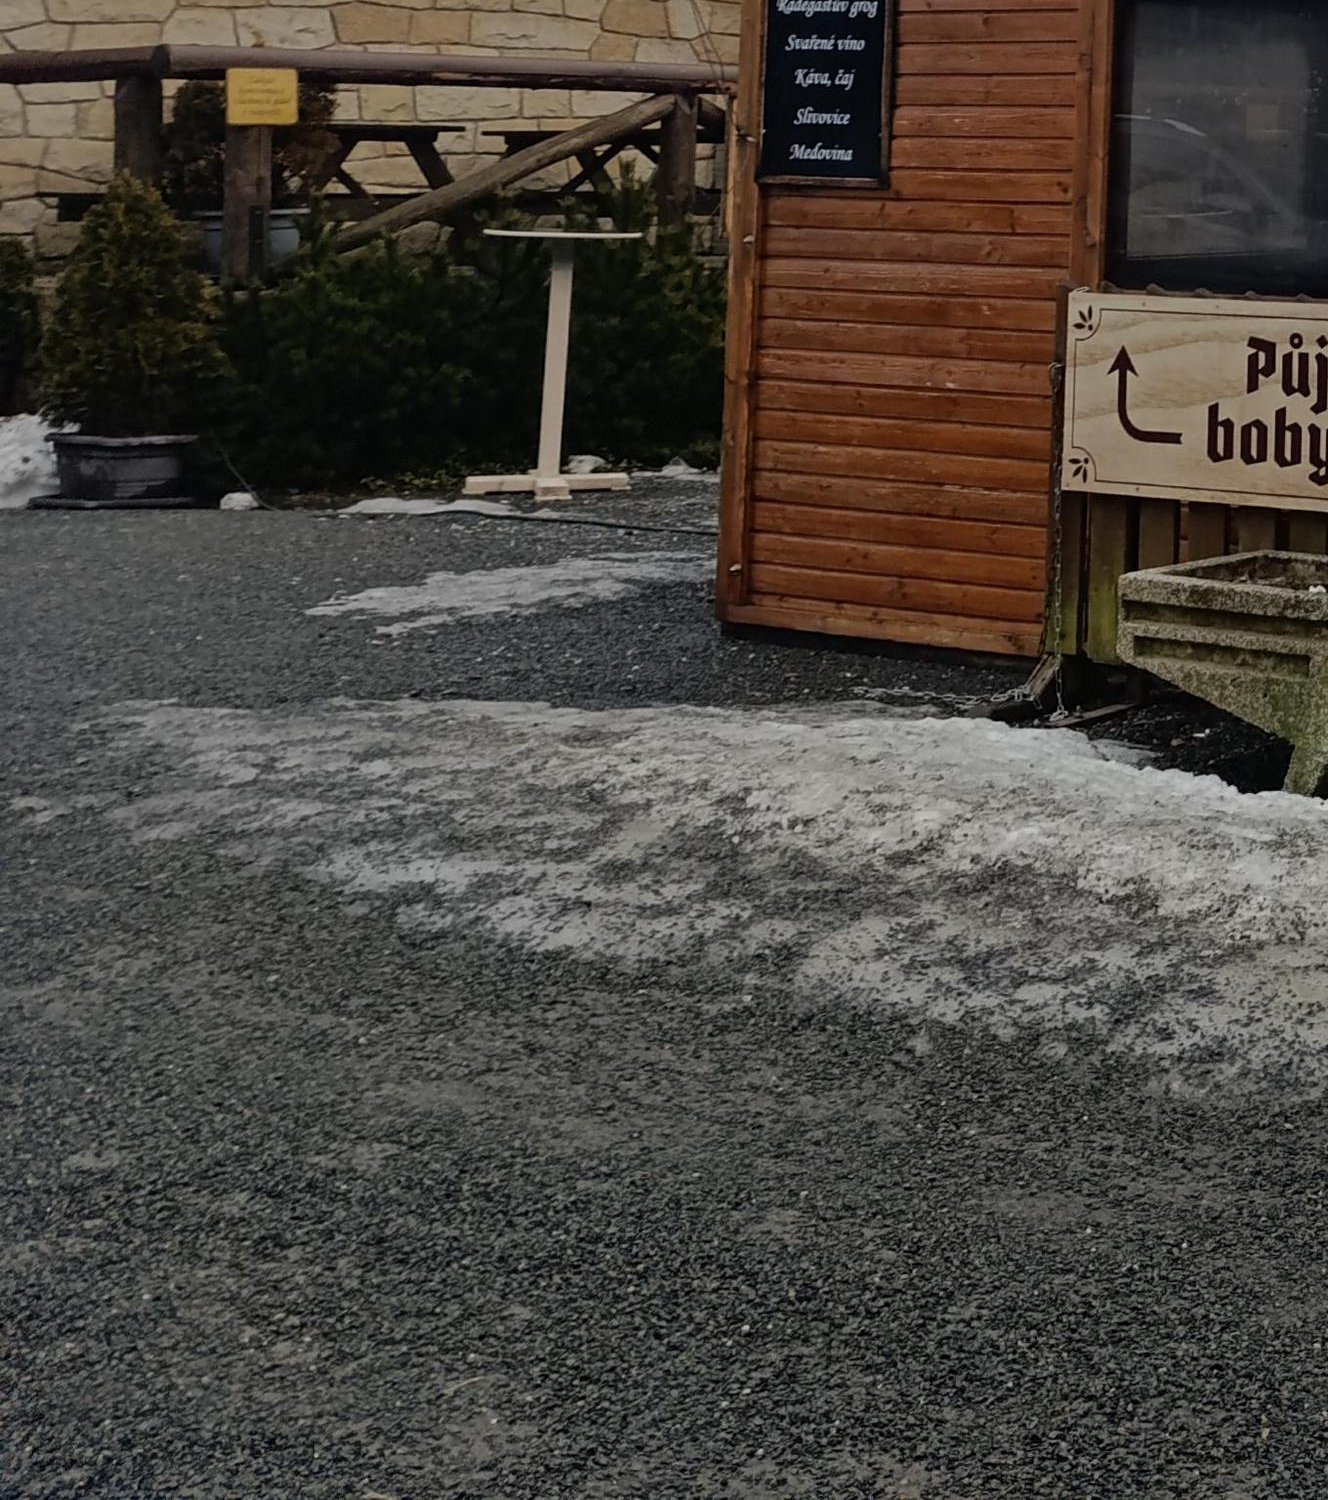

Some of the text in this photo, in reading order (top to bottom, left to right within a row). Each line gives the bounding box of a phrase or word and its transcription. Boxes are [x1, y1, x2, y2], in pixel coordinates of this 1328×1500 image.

[848, 1, 878, 18] grog
[785, 34, 866, 51] Svařené víno
[794, 68, 856, 91] Káva, čaj
[793, 106, 851, 125] Slivovice
[789, 142, 853, 161] Medovina
